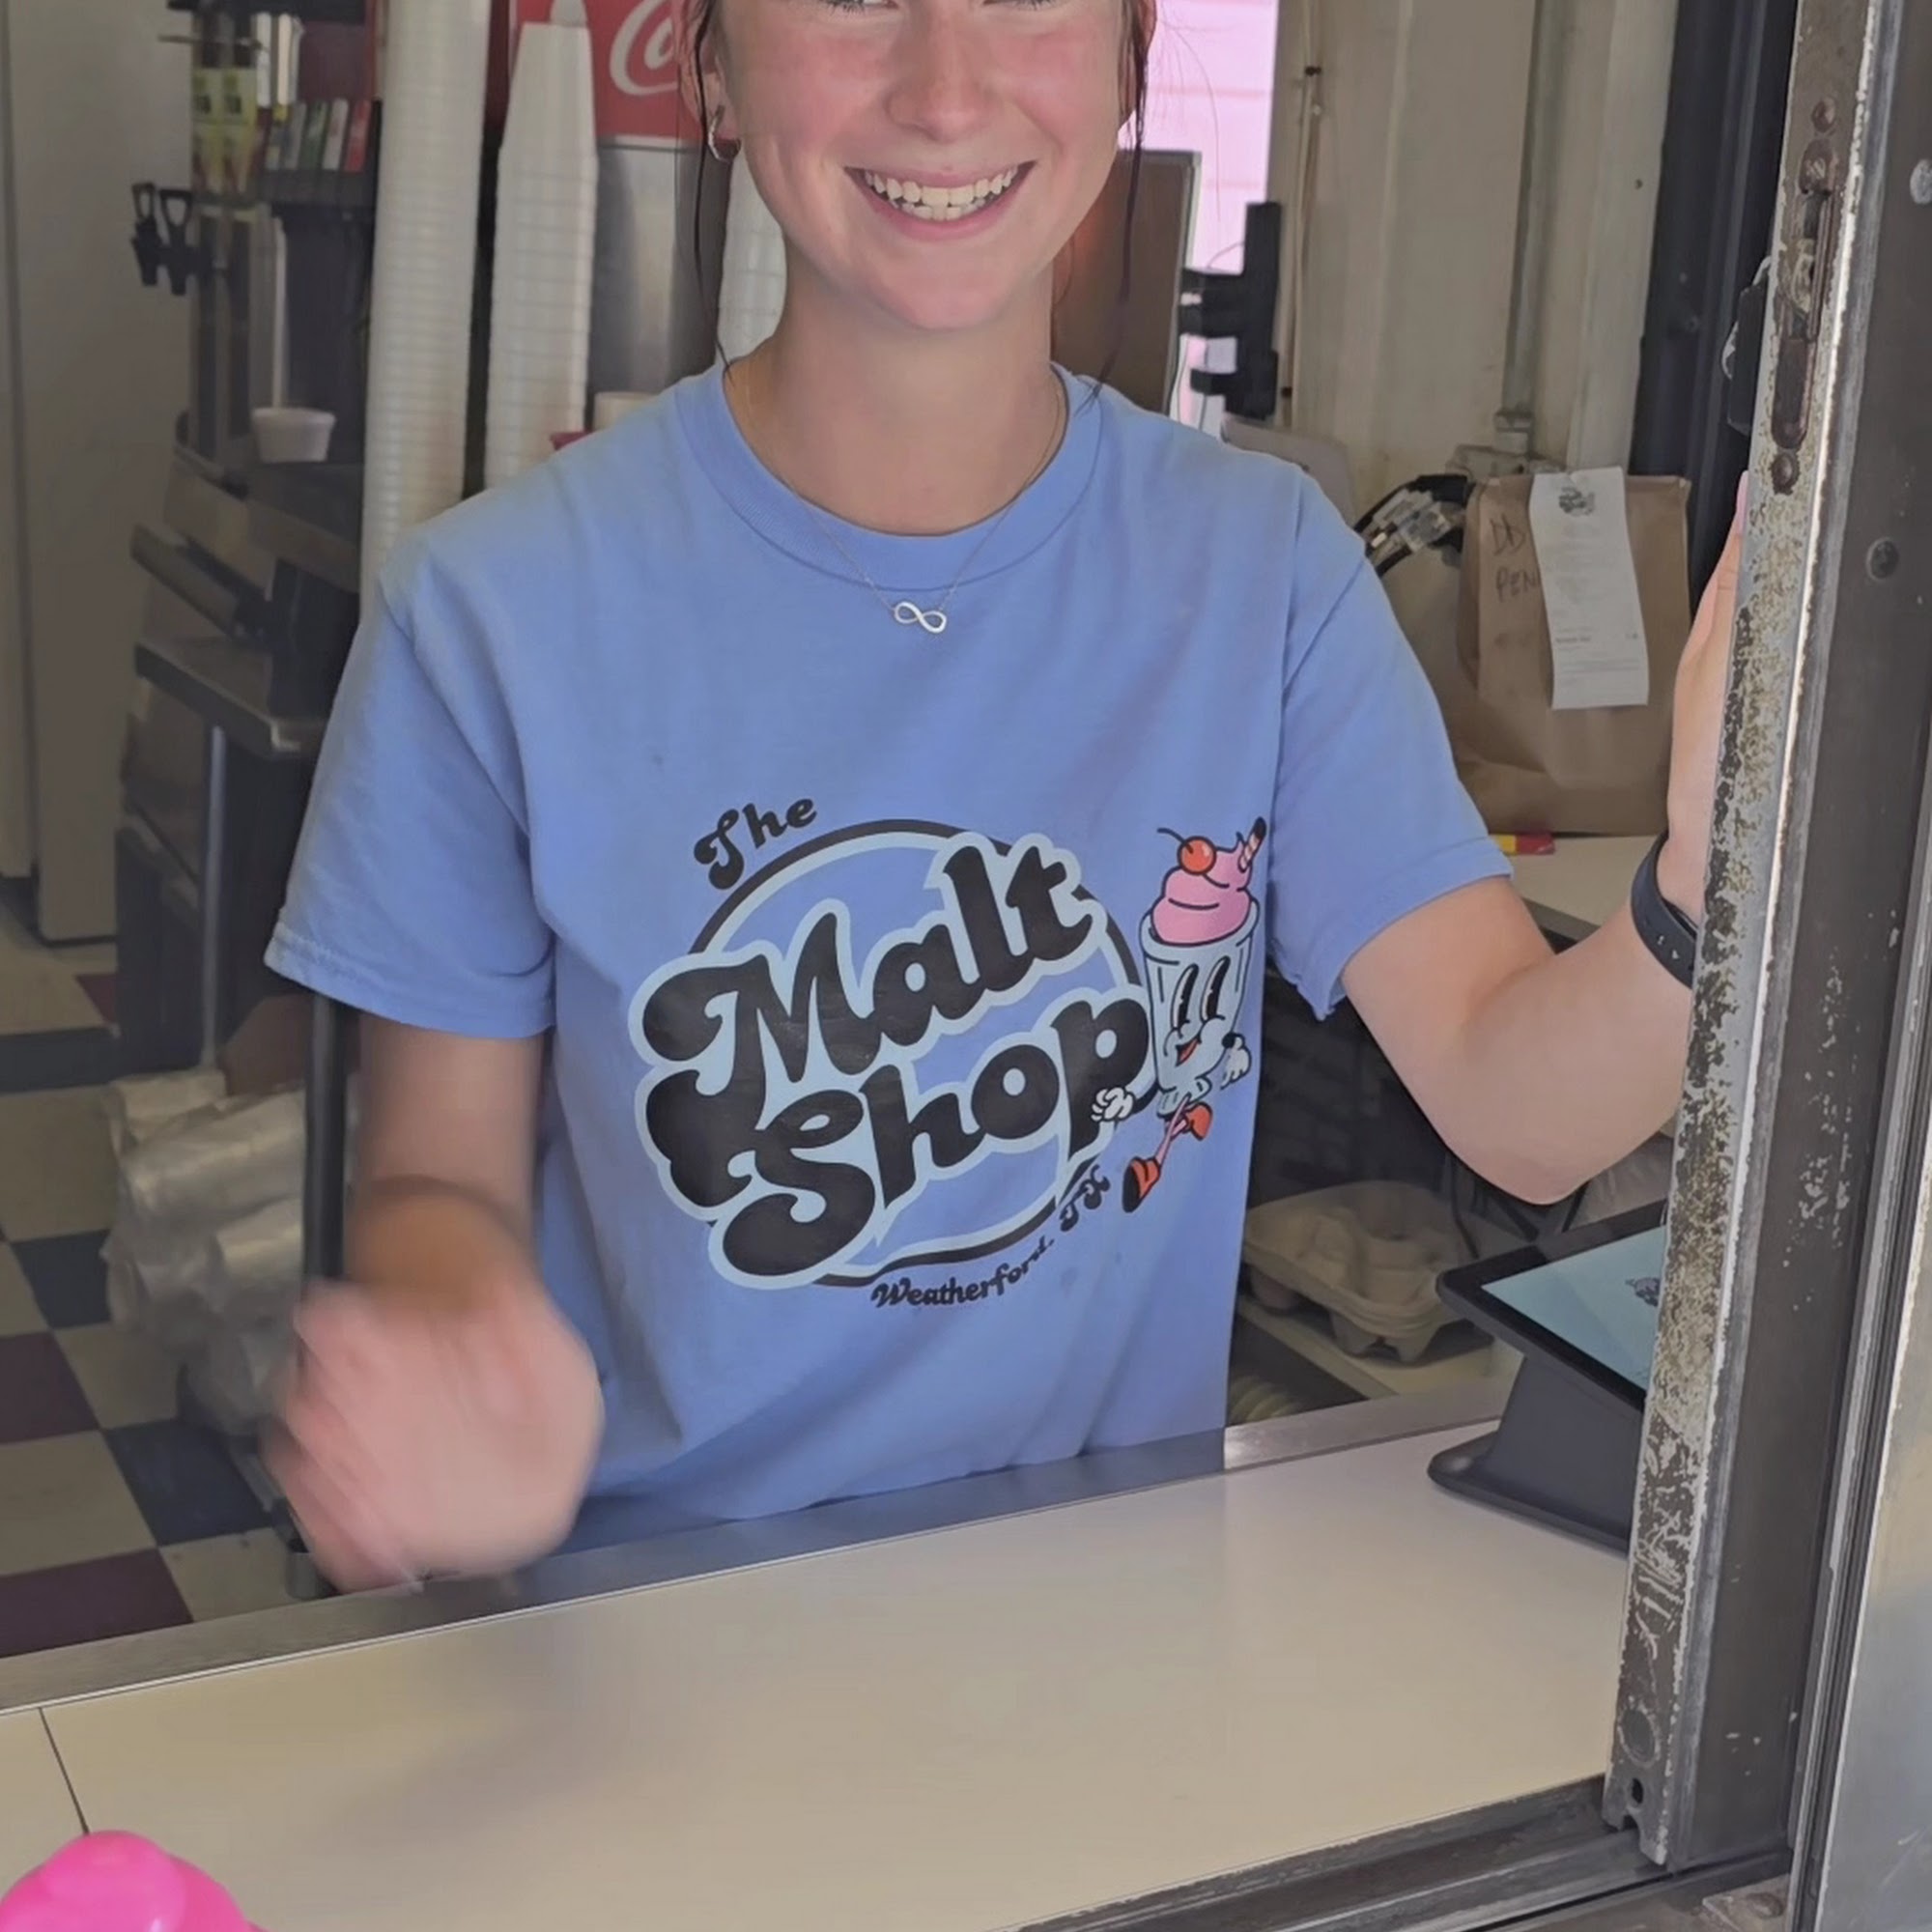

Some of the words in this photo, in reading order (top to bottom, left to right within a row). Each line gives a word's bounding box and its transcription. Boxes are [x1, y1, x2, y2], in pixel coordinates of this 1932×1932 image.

[694, 798, 817, 891] The
[642, 845, 1094, 1084] Malt
[645, 999, 1150, 1277] Shop
[1059, 1163, 1111, 1232] TX
